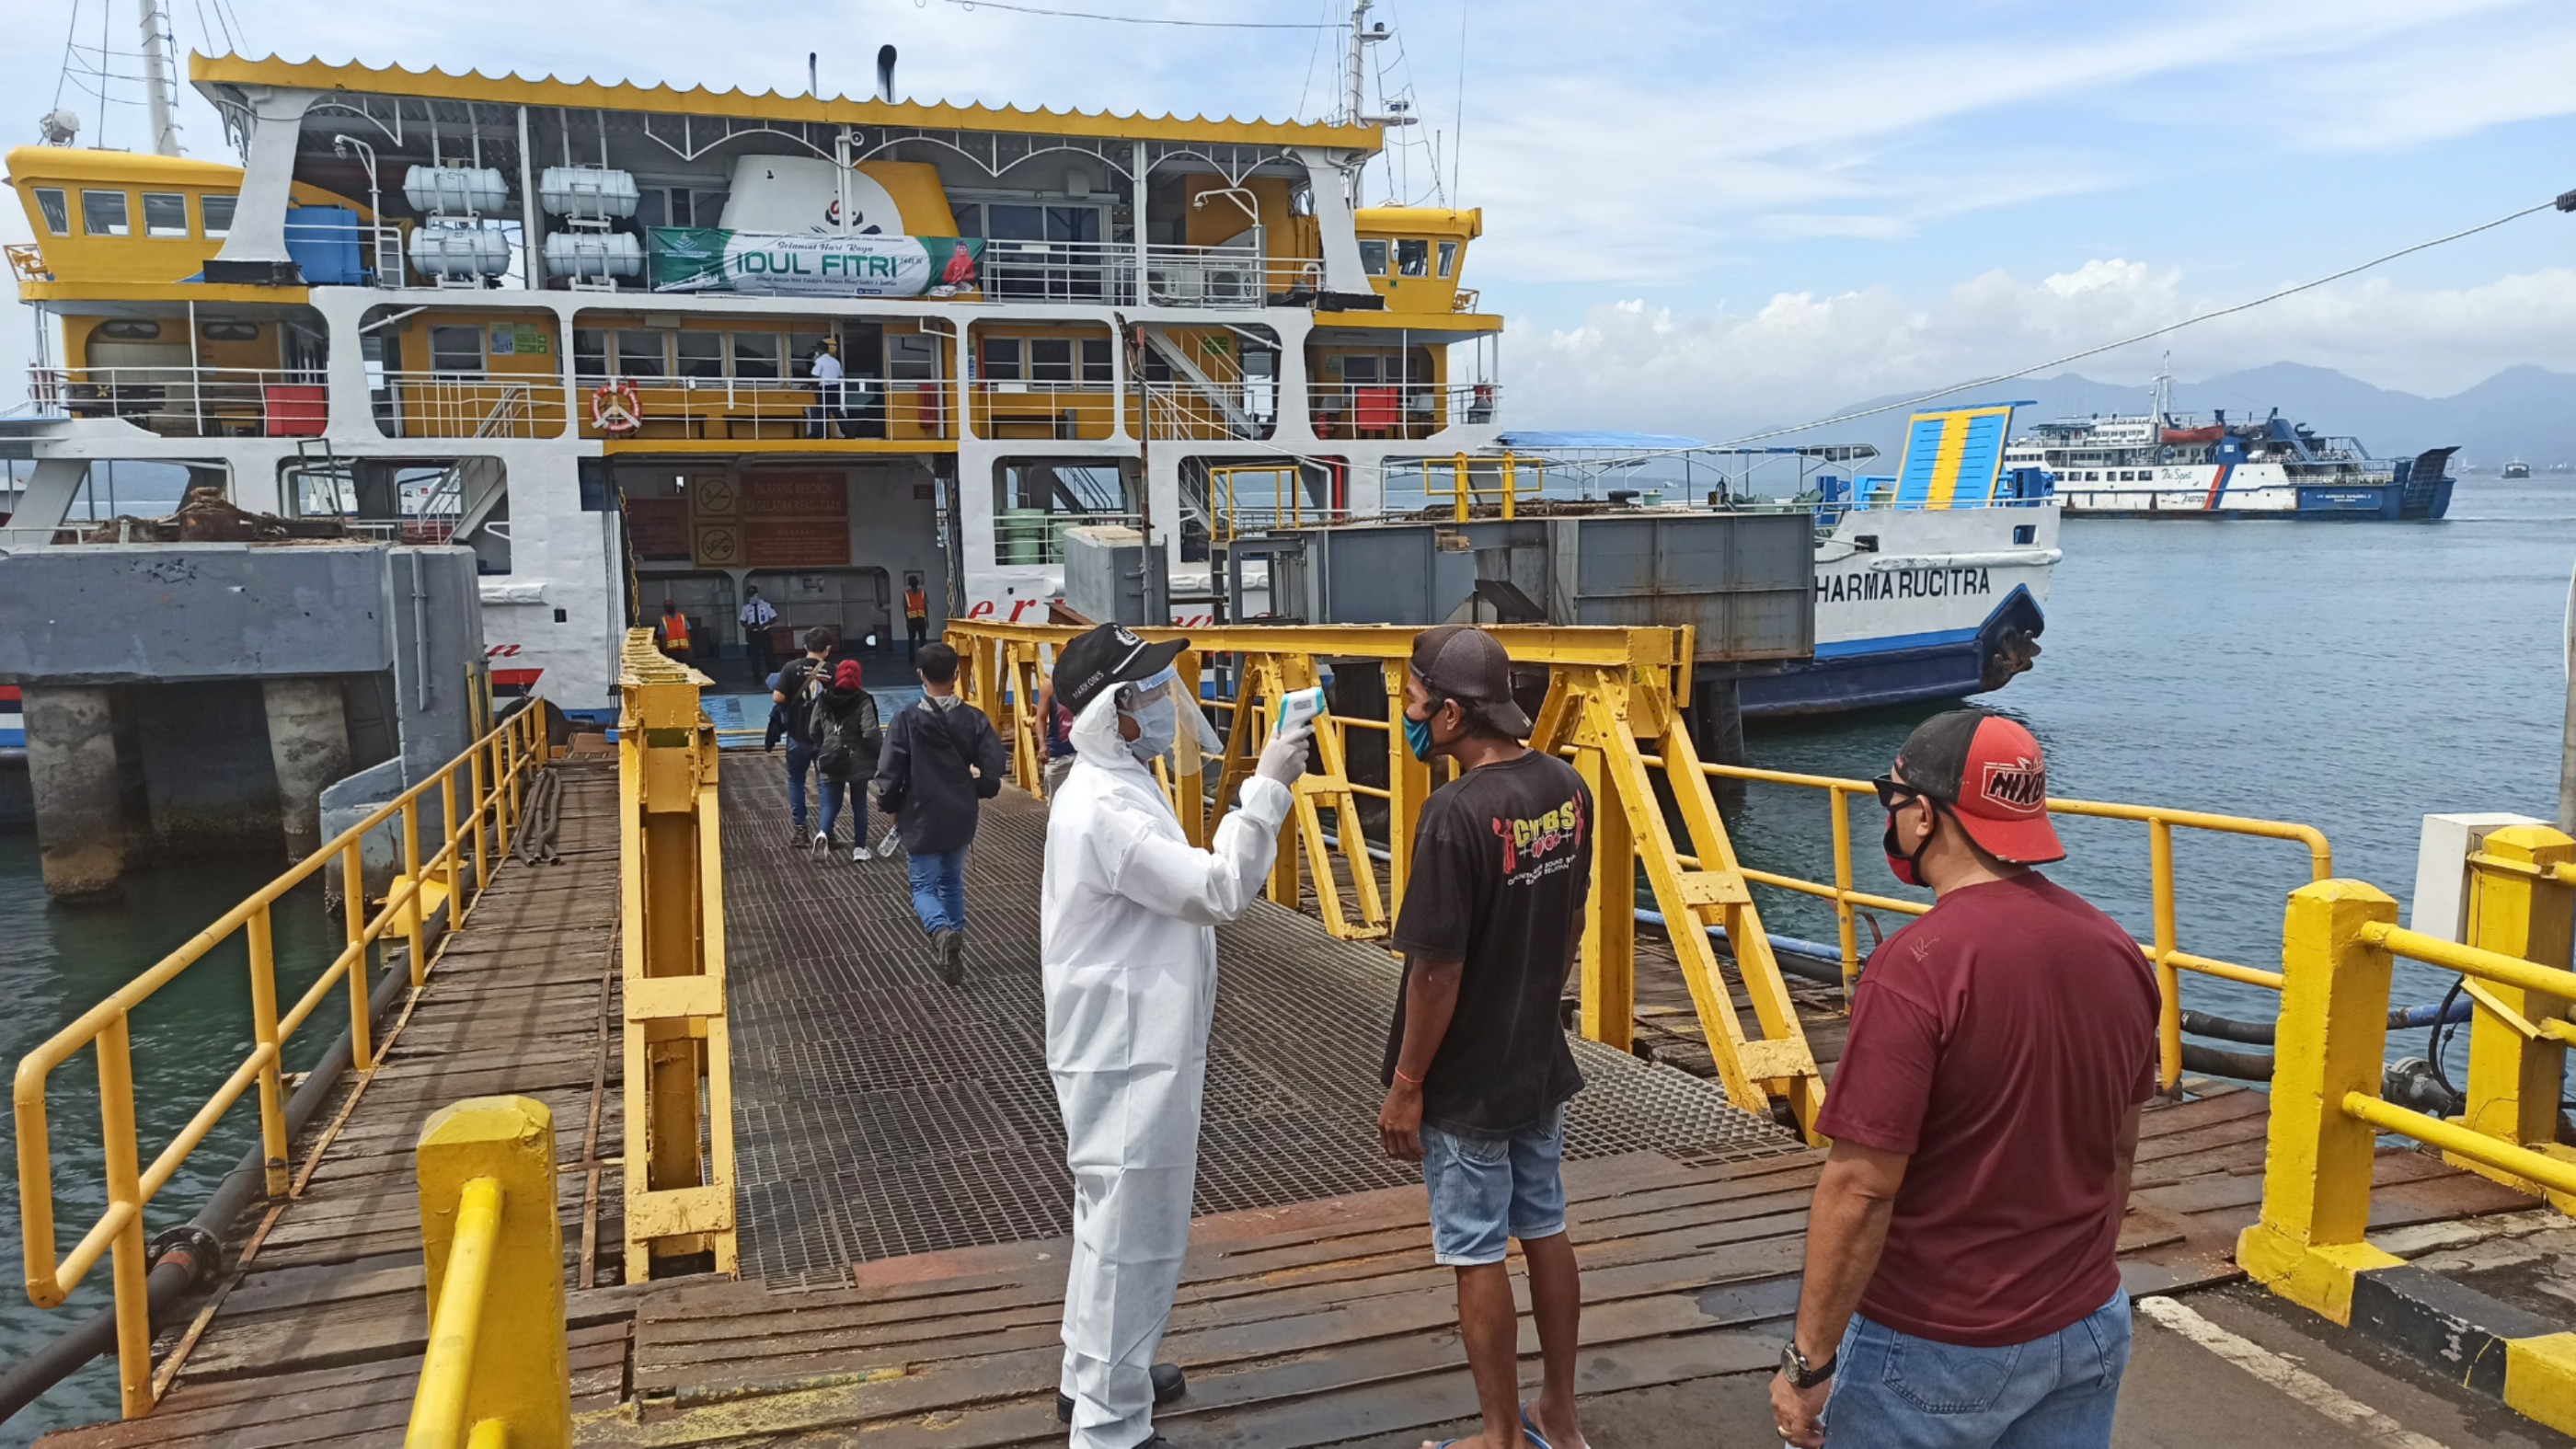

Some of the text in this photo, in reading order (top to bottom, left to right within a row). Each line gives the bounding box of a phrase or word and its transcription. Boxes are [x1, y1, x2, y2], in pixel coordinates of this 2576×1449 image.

[777, 240, 874, 254] Selamat Hari Raya
[737, 251, 811, 274] IDUL
[822, 254, 897, 278] FITRI
[1899, 568, 1991, 599] RUCITRA
[1072, 670, 1105, 700] MARKONIS
